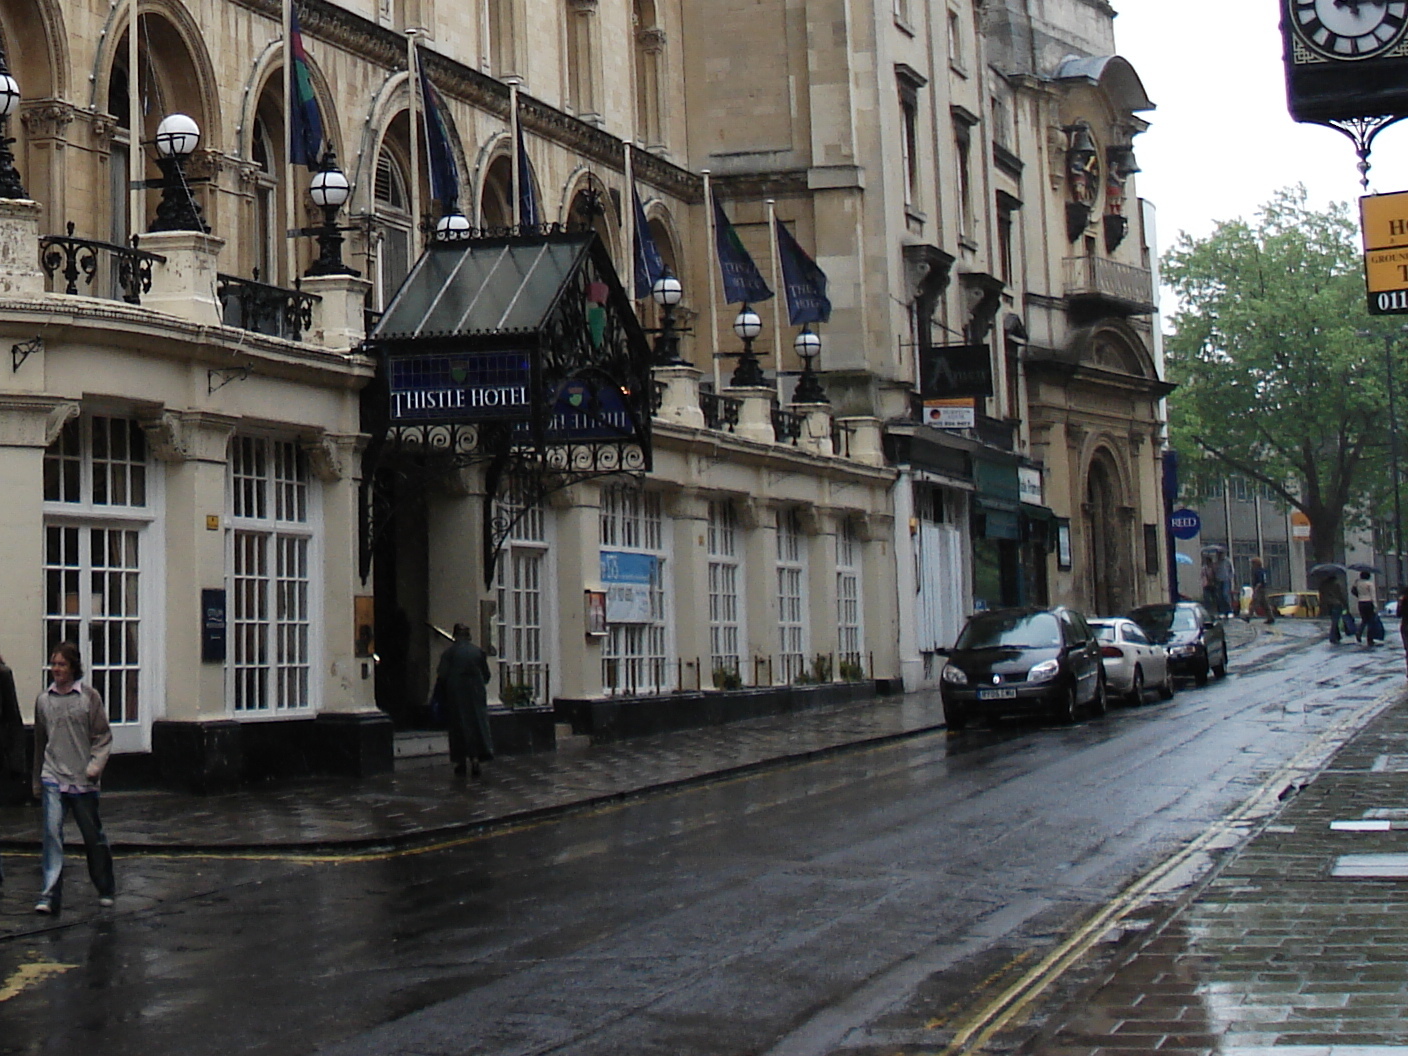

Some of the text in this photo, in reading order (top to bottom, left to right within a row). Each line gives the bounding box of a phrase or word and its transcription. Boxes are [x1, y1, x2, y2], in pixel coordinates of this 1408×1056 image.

[1389, 219, 1408, 236] H
[1378, 292, 1408, 311] 011
[390, 385, 531, 418] THISTLE HOTEL
[1171, 517, 1197, 528] REED
